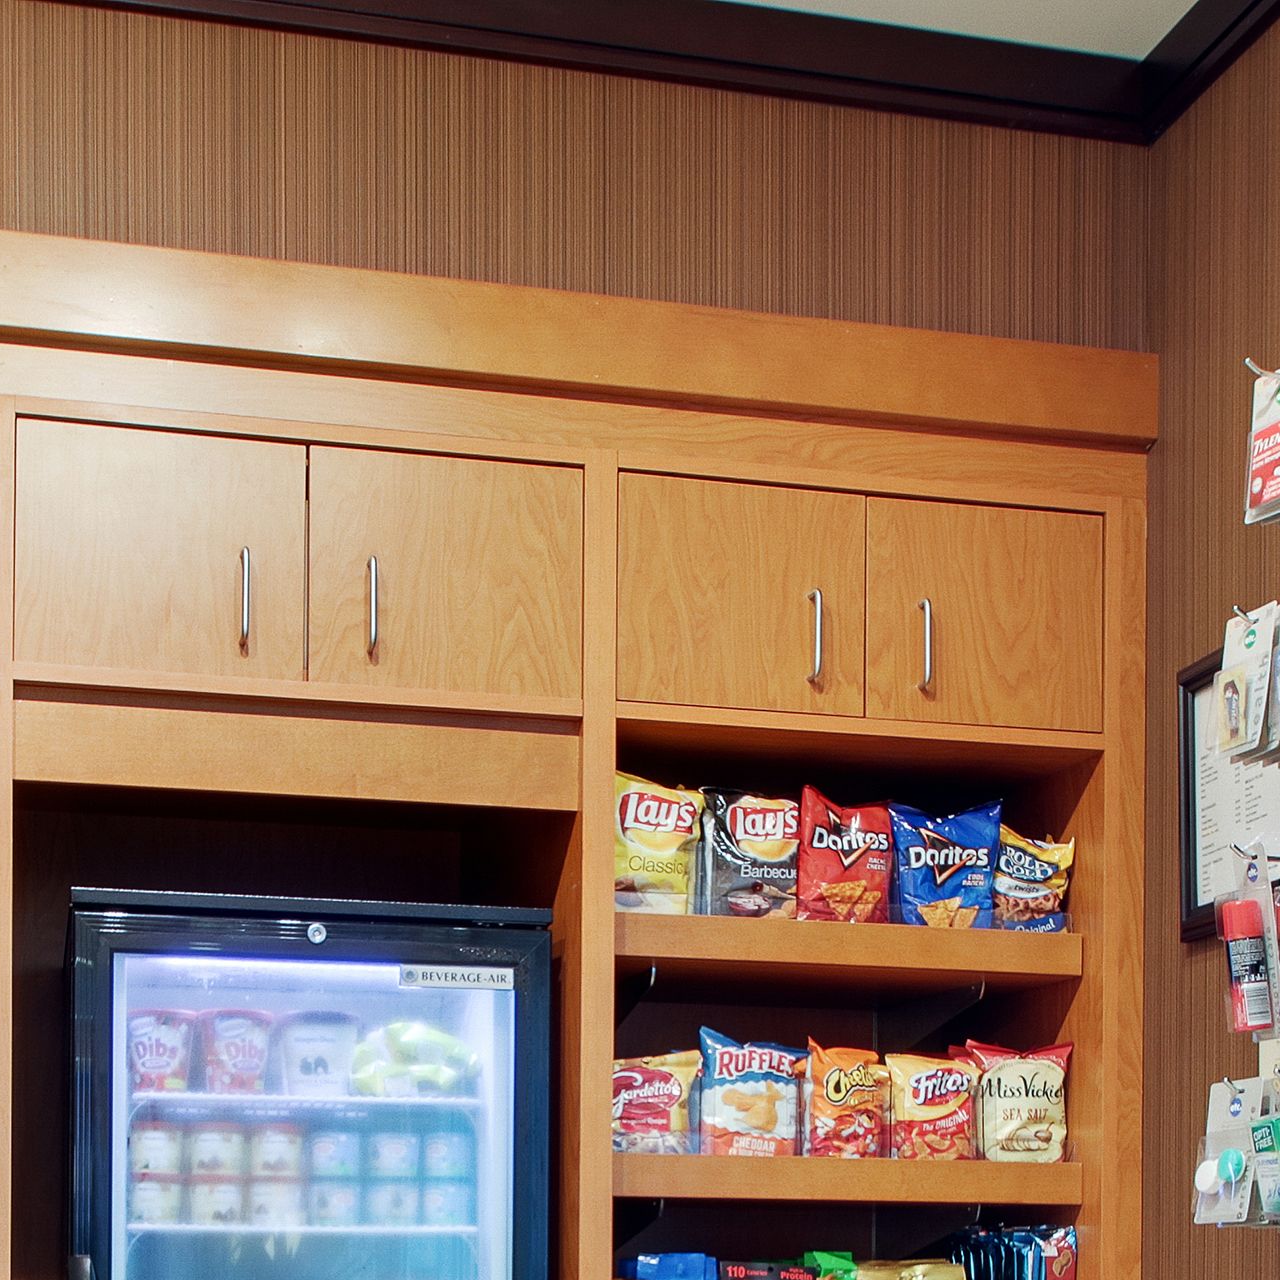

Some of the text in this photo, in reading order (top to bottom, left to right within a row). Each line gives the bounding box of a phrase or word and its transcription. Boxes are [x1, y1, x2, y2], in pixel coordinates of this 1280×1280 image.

[624, 793, 695, 833] Lay's
[736, 806, 799, 842] Lay's
[812, 827, 889, 851] Doritos
[628, 855, 685, 876] Classic
[909, 847, 989, 869] Doritos
[999, 857, 1054, 880] GOLD
[1005, 847, 1050, 871] ROLD
[1014, 884, 1040, 893] twists
[1015, 917, 1057, 934] Original
[422, 971, 508, 983] BEVERAGE-AIR
[135, 1038, 177, 1059] Dibs
[225, 1039, 263, 1060] Dibs
[716, 1048, 797, 1079] RUFFLES
[910, 1069, 972, 1105] Fritos
[984, 1077, 1022, 1099] Miss
[935, 1109, 970, 1130] ORIGINAL
[1002, 1107, 1048, 1121] SEA SALT
[733, 1135, 776, 1151] CHEDDAR
[1254, 1126, 1271, 1140] OPTI-
[1256, 1138, 1273, 1151] FREE
[727, 1265, 745, 1278] 110
[780, 1272, 813, 1280] Protein
